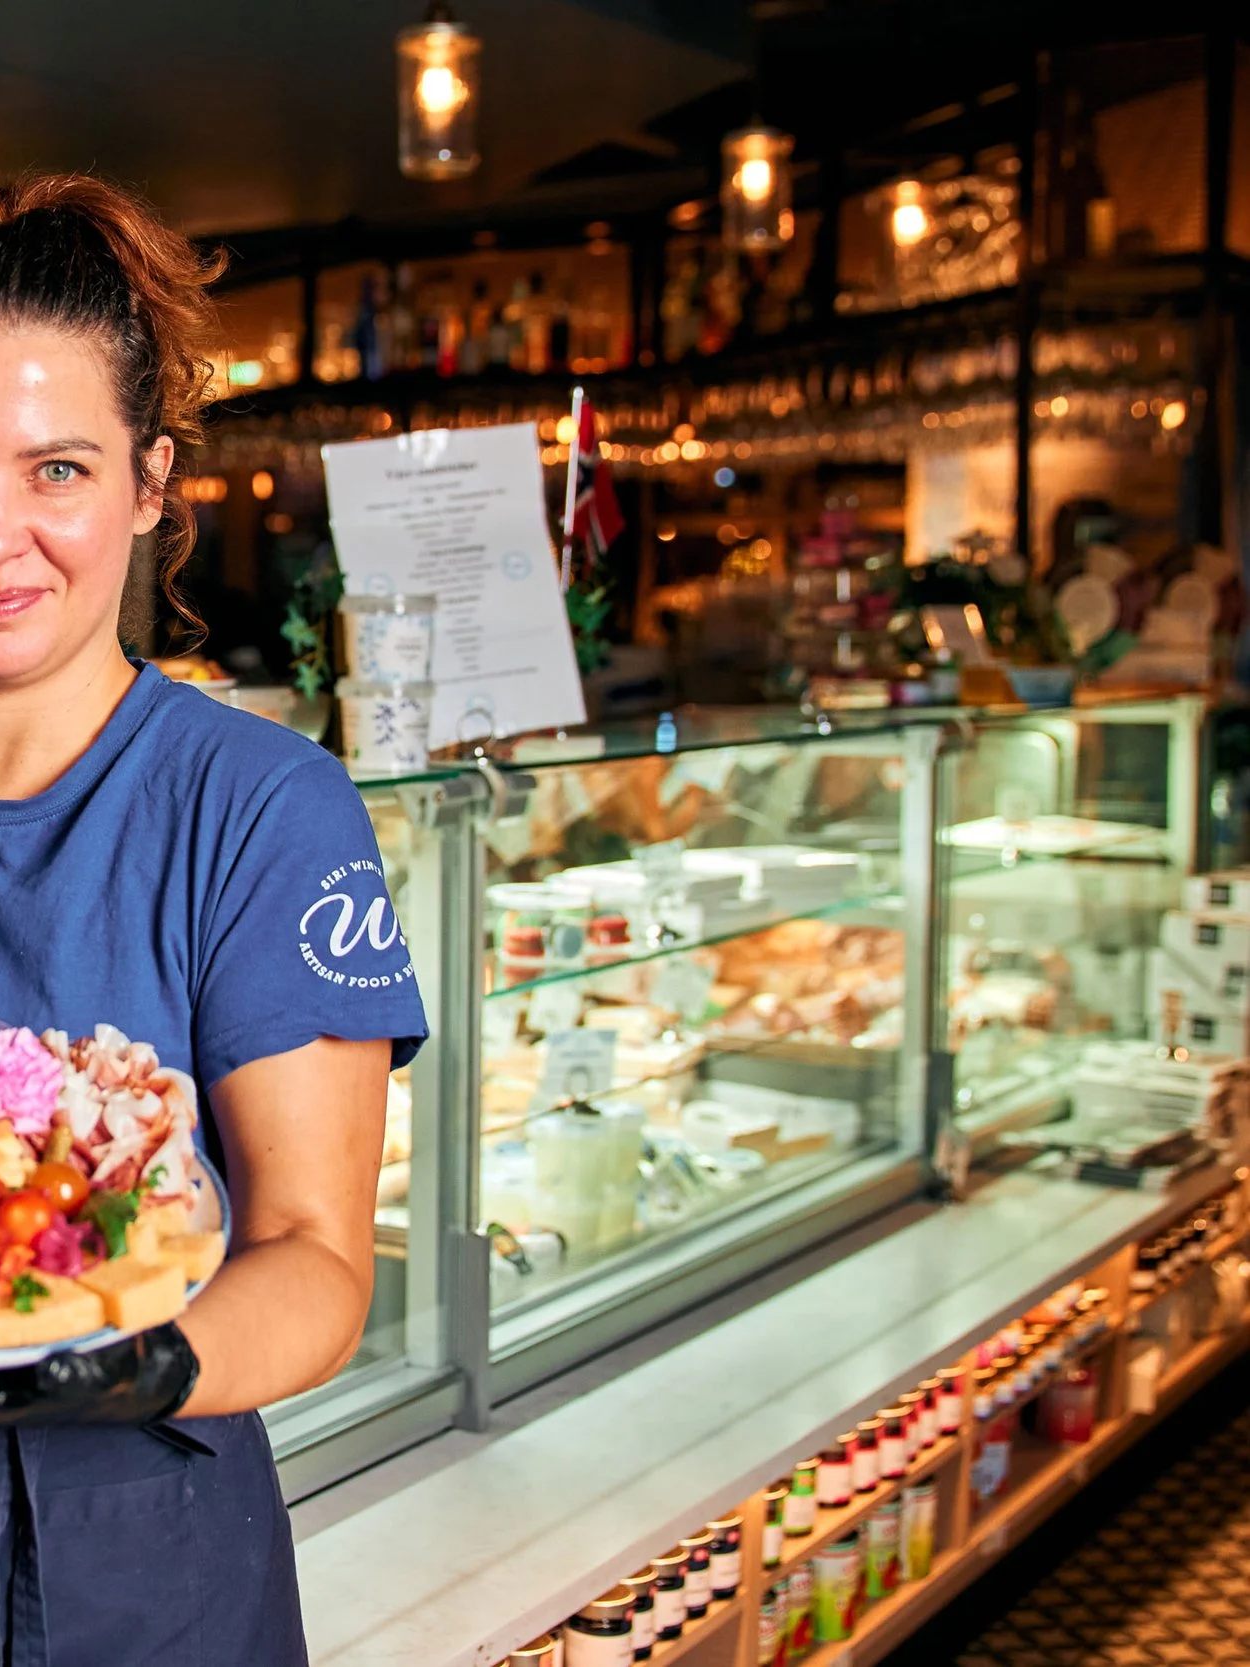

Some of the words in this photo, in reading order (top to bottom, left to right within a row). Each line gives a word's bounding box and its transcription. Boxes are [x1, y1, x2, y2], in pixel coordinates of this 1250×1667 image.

[320, 866, 348, 891] SIRI
[299, 942, 346, 985] ARTISAN
[348, 975, 391, 988] FOOD
[394, 972, 403, 983] &
